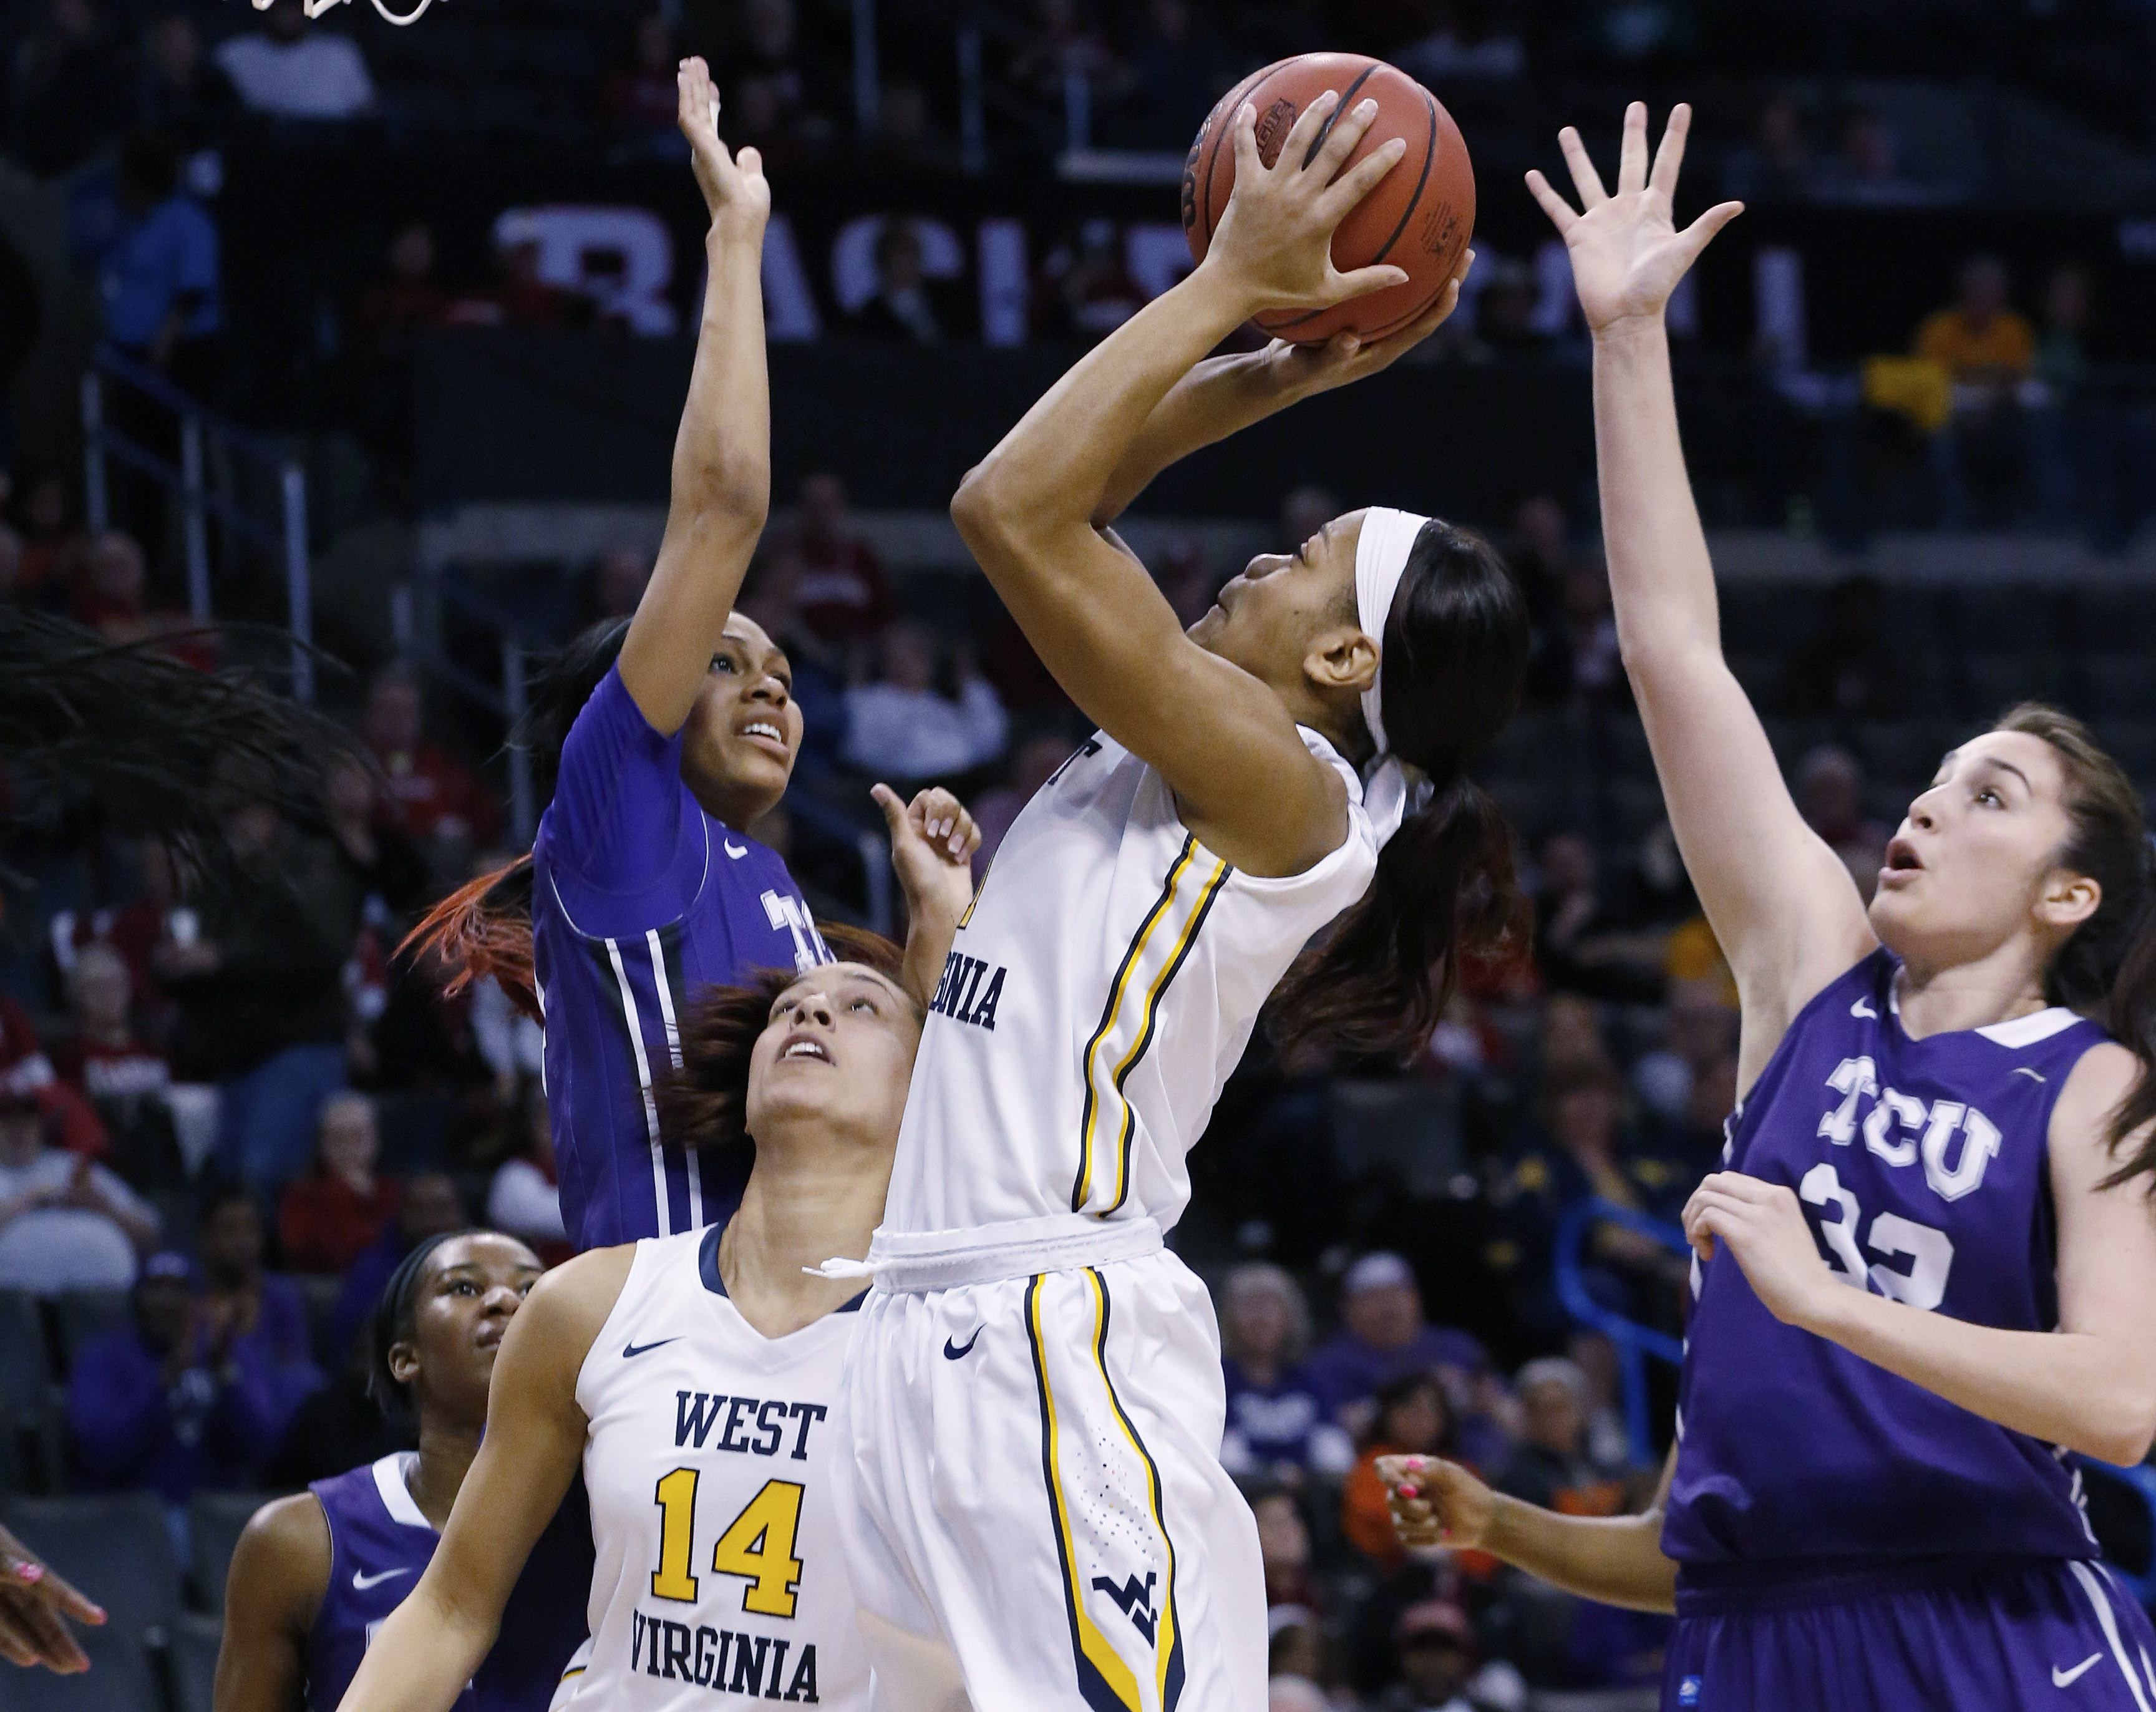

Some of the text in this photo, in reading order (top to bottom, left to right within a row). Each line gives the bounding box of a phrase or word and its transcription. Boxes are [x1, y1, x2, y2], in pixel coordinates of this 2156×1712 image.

[1817, 1055, 2003, 1203] TCU
[1799, 1162, 1955, 1311] 32
[675, 1391, 828, 1461] WEST
[651, 1467, 806, 1620] 14
[632, 1608, 820, 1704] VIRGINIA
